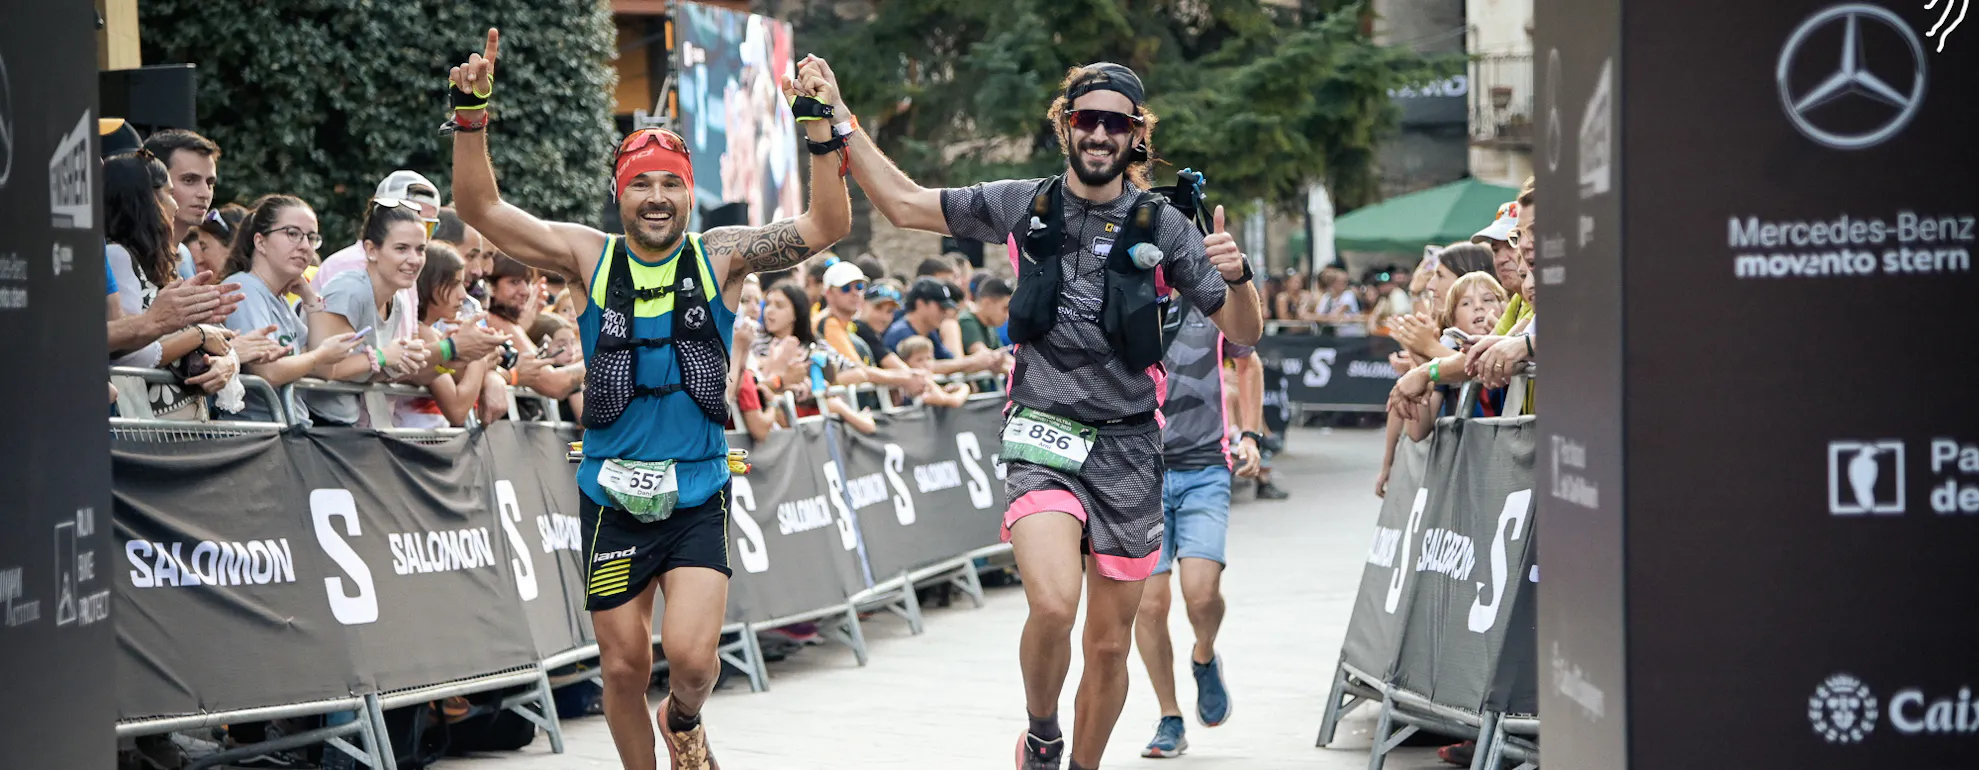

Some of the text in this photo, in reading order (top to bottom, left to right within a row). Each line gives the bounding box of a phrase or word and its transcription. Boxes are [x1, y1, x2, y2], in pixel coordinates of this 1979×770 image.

[1728, 211, 1975, 248] Mercedes-Benz
[1734, 247, 1970, 277] movento stern
[600, 320, 627, 339] MAX
[1303, 347, 1337, 388] S
[1029, 424, 1072, 450] 856
[956, 431, 993, 509] S
[1931, 440, 1979, 473] Pa
[637, 489, 652, 497] Dani
[883, 443, 916, 526] S
[1930, 479, 1979, 512] de
[731, 476, 769, 573] S
[777, 495, 833, 535] SALOMON
[823, 460, 857, 551] S
[125, 538, 296, 588] SALOMON
[309, 488, 379, 625] S
[388, 527, 496, 576] SALOMON
[495, 479, 539, 601] S
[593, 546, 636, 563] land
[1385, 487, 1428, 614] S
[1416, 528, 1476, 581] SALOMON
[1468, 488, 1532, 633] S
